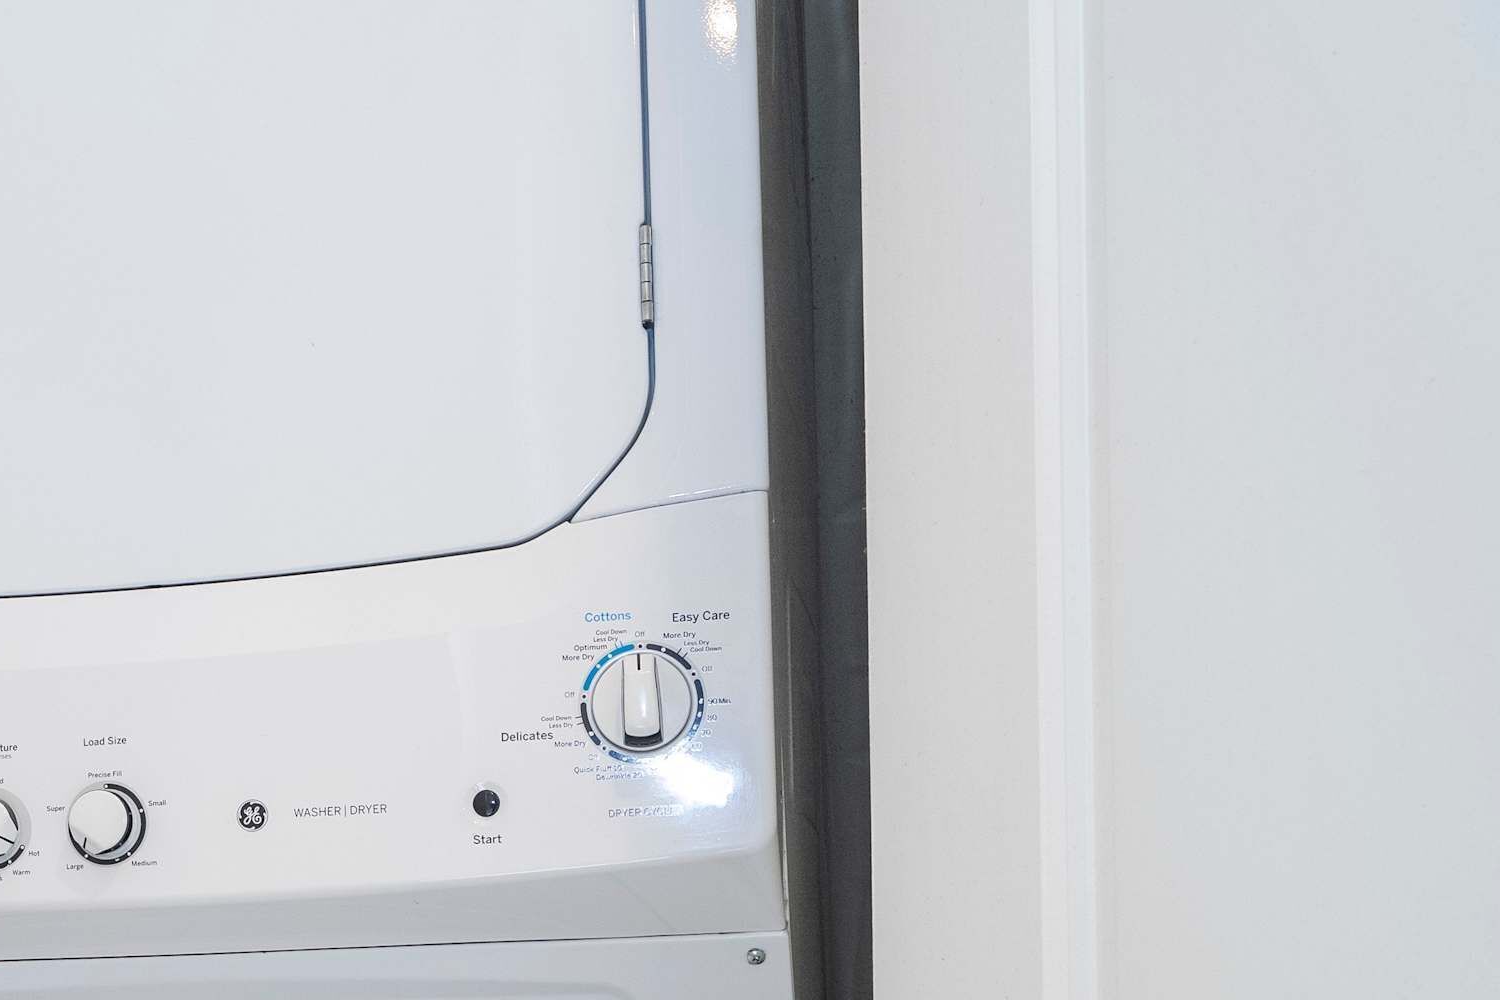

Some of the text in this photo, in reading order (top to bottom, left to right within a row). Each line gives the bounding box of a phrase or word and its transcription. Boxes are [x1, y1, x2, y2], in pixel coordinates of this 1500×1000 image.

[584, 612, 632, 623] Cottons
[672, 610, 730, 623] Easy Care
[573, 644, 608, 652] Optimum
[83, 736, 127, 747] Load Size
[501, 731, 554, 742] Delicates
[46, 805, 65, 813] Super
[293, 803, 388, 818] WASHER DRYER
[473, 834, 502, 845] Start
[66, 863, 84, 871] Large
